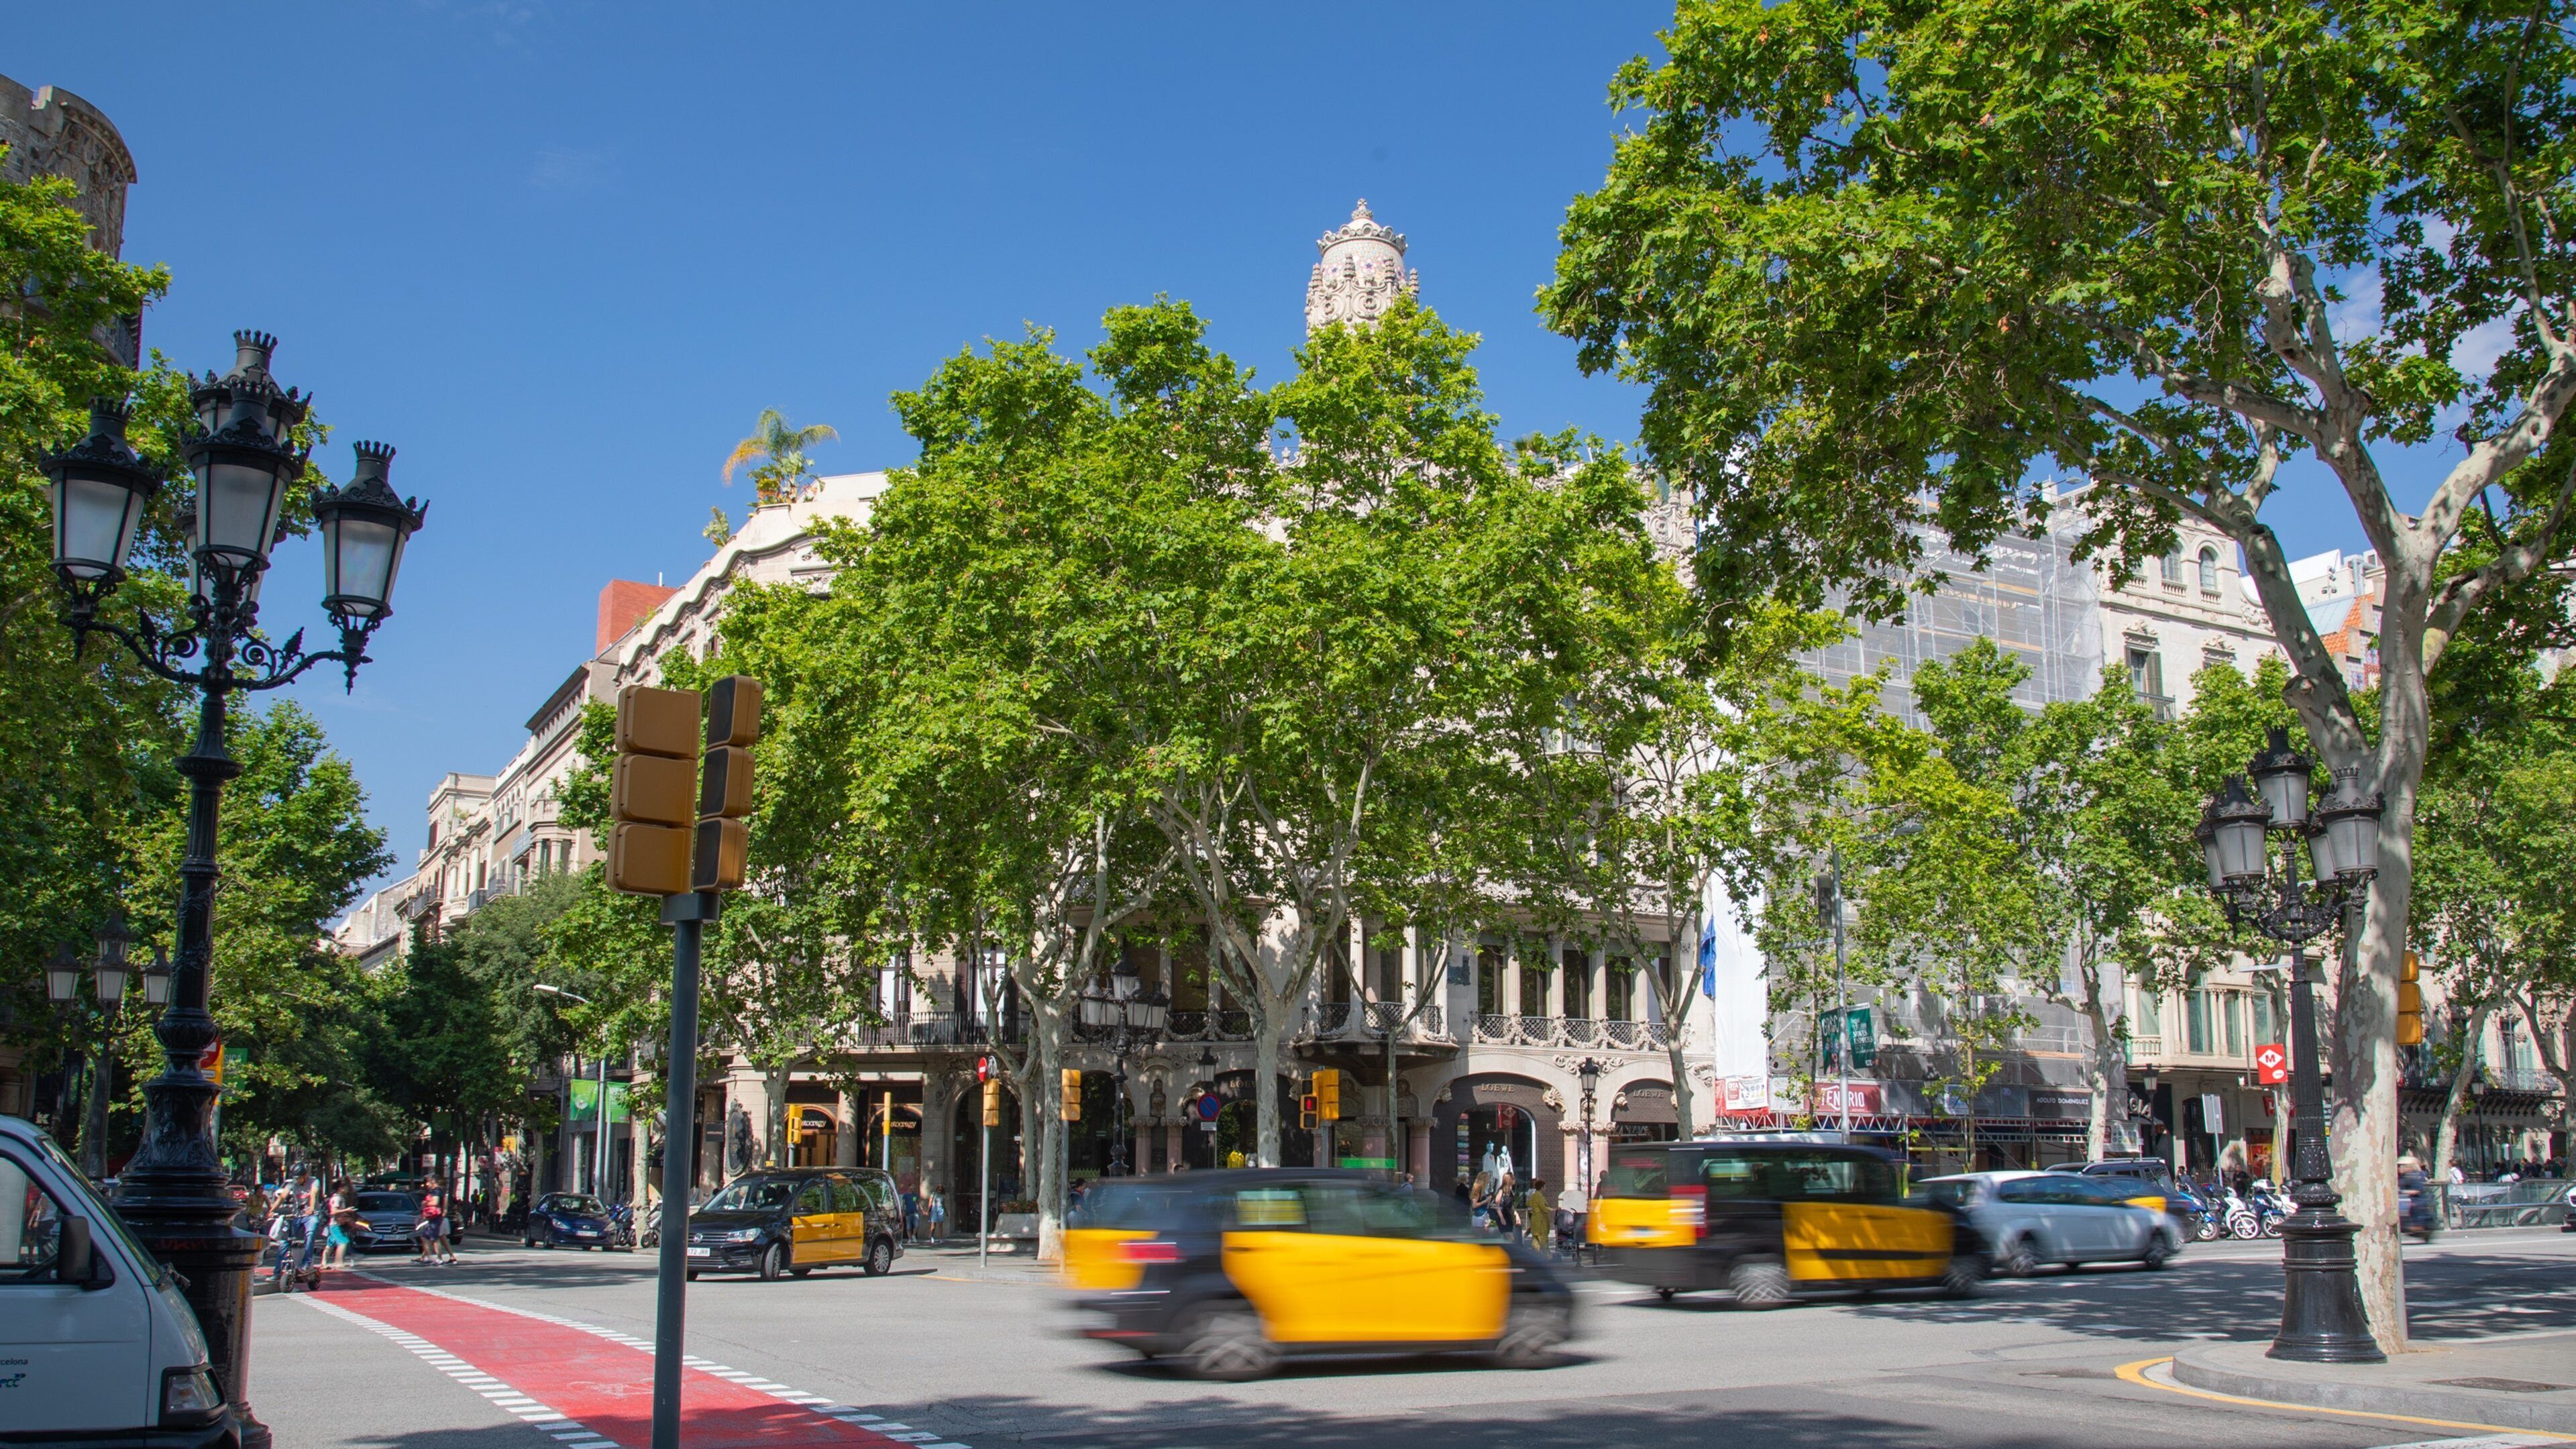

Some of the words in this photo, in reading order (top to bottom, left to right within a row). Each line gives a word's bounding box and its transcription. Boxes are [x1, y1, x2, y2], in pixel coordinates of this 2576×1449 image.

[2265, 1054, 2275, 1063] M
[1481, 1083, 1515, 1093] LOEWE
[1633, 1088, 1664, 1098] LOEWE
[1821, 1085, 1865, 1110] TENRIO
[2129, 1097, 2152, 1118] GIA
